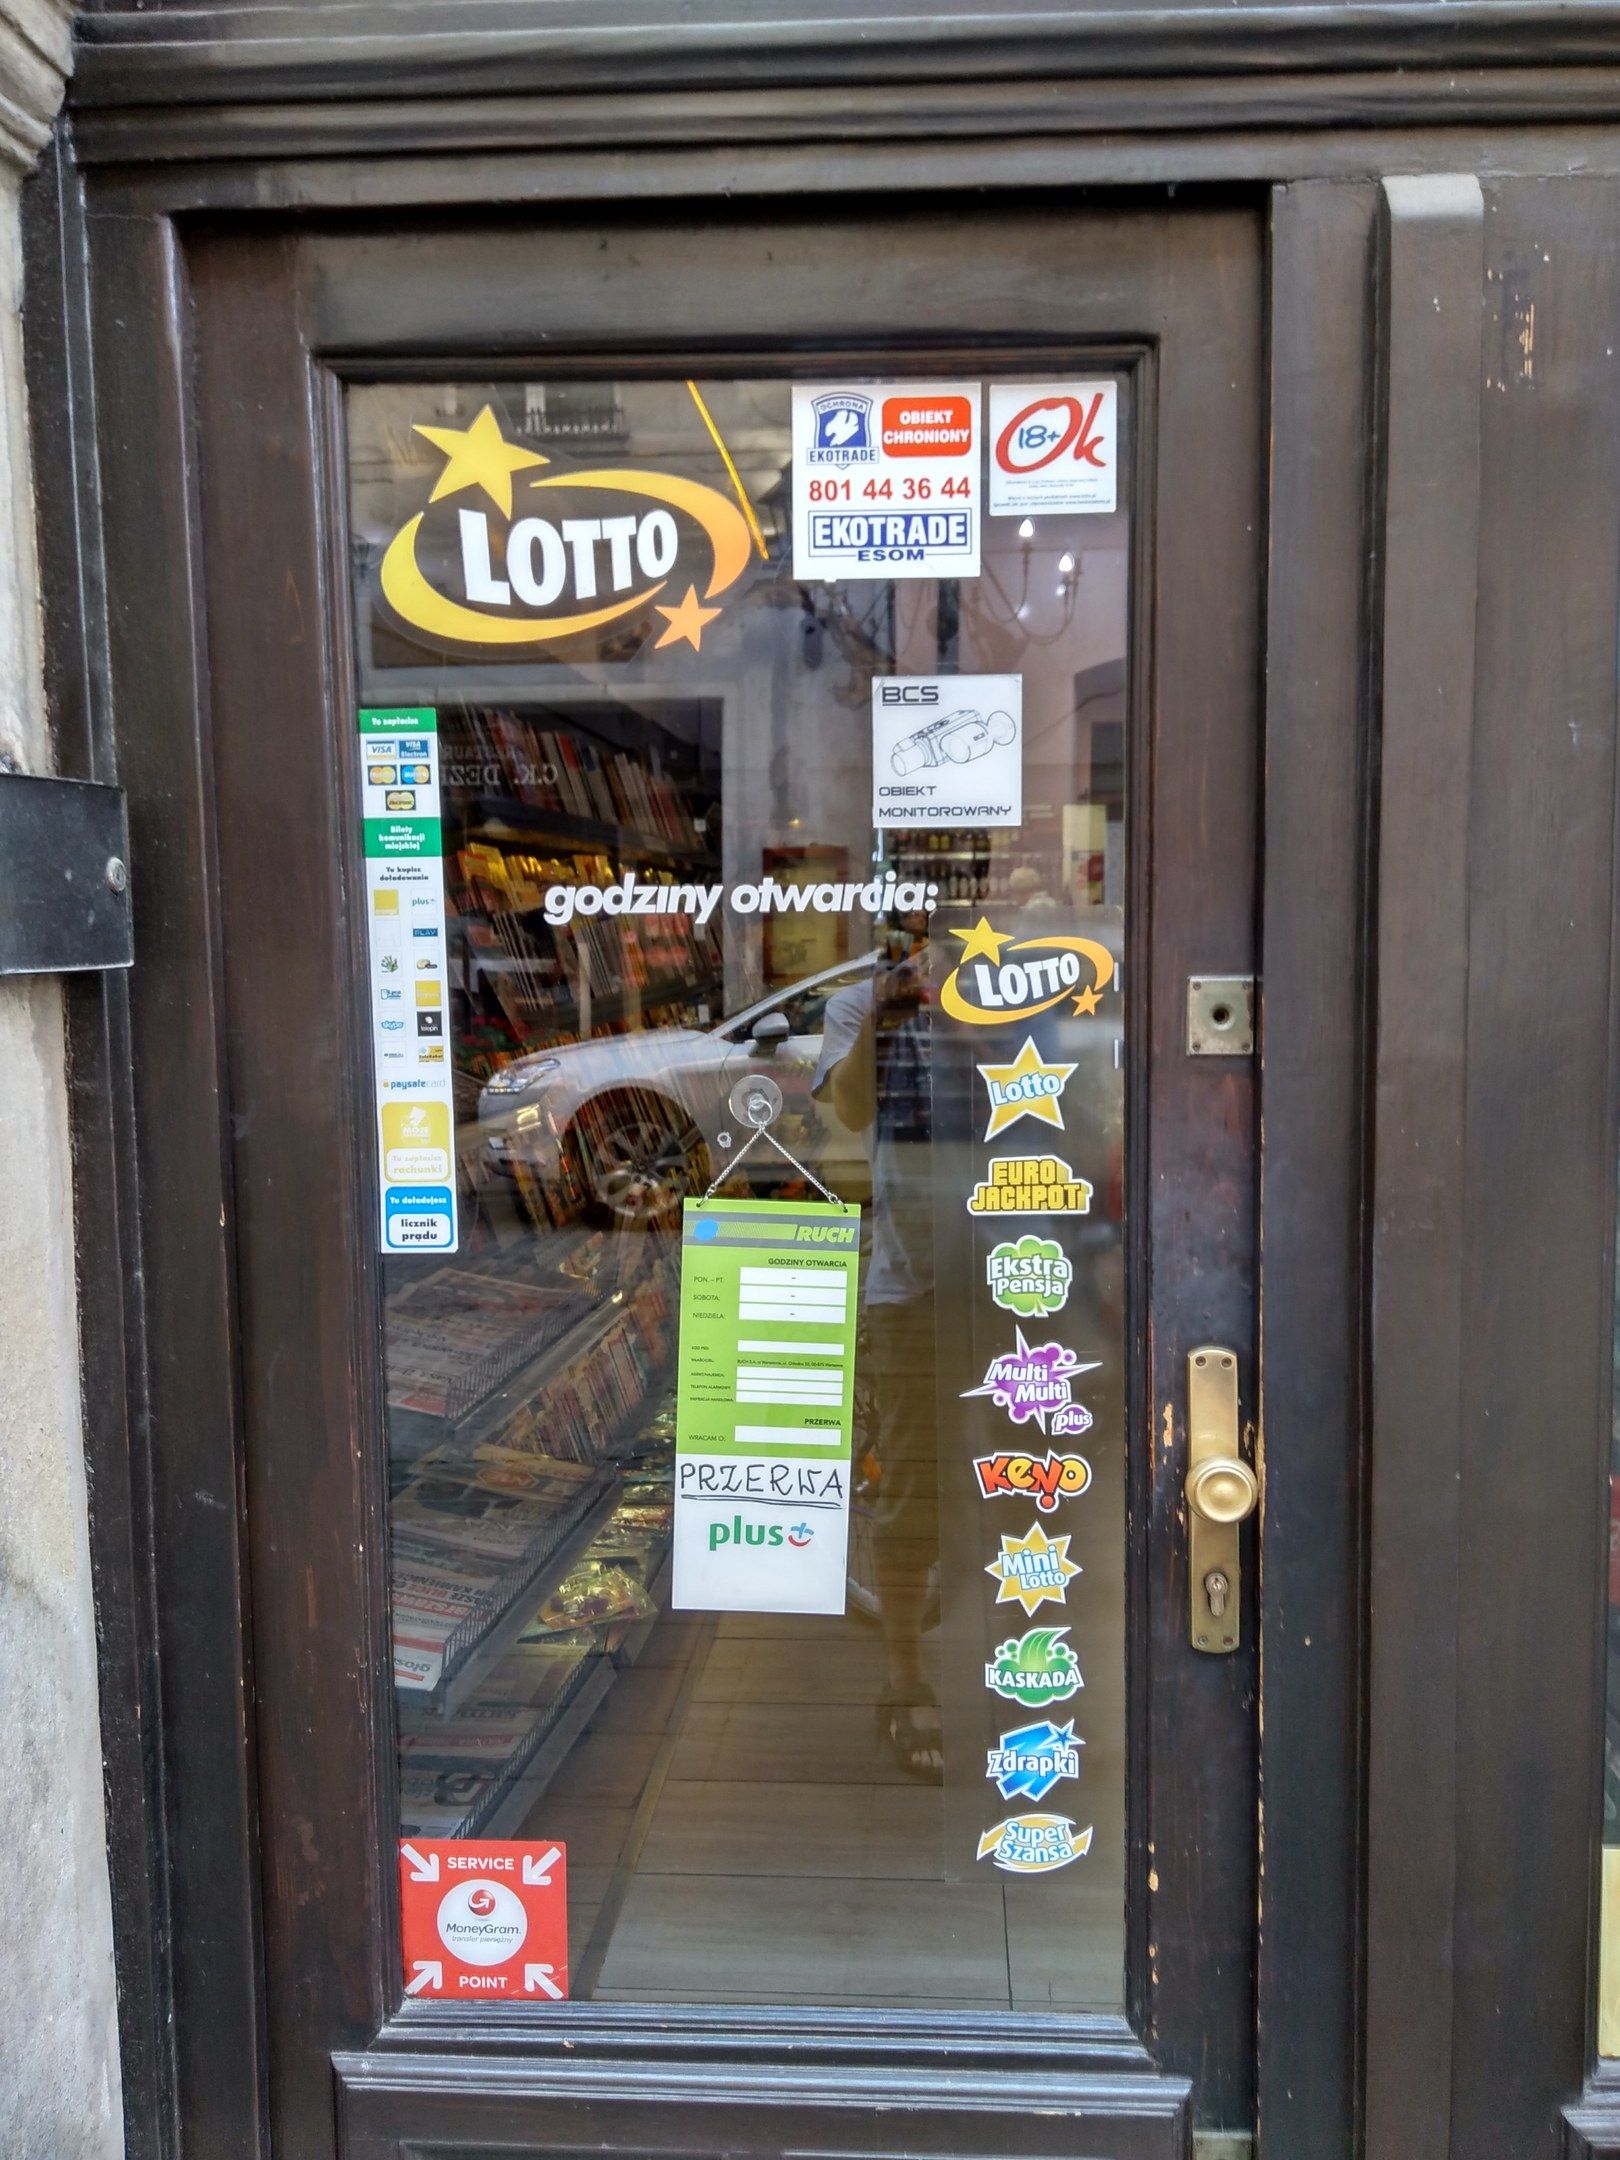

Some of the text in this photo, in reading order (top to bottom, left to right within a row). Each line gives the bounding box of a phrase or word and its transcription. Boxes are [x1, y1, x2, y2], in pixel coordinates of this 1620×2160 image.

[819, 397, 865, 412] OCHRONA
[899, 410, 954, 425] OBIEKT
[883, 427, 970, 445] CHRONIONY
[1018, 426, 1061, 449] 18+
[809, 448, 876, 463] EKOTRADE
[809, 476, 971, 501] 801 44 36 44
[814, 517, 967, 548] EKOTRADE
[458, 508, 678, 607] LOTTO
[858, 549, 925, 562] ESOM
[882, 685, 939, 703] BCS
[371, 746, 392, 754] VISA
[405, 741, 421, 749] VISA
[400, 751, 428, 759] Electron
[878, 785, 937, 797] OBIEKT
[878, 805, 1012, 818] MONITOROWANY
[731, 871, 939, 912] otwarcia:
[411, 897, 430, 907] plus
[413, 929, 437, 937] PLAY
[974, 952, 1081, 1007] LOTTO
[390, 1080, 446, 1091] paysafecard
[991, 1071, 1062, 1108] Lotto
[393, 1164, 442, 1174] rachunki
[992, 1159, 1059, 1187] EURO
[389, 1196, 400, 1205] Tu
[971, 1183, 1084, 1212] JACKPOT
[400, 1218, 438, 1228] licznik
[401, 1229, 438, 1242] prądu
[796, 1226, 855, 1244] RUCH
[767, 1257, 848, 1269] GODZINY OTWARCIA
[989, 1253, 1070, 1280] Ekstra
[995, 1275, 1065, 1298] Pensja
[990, 1361, 1049, 1382] Multi
[1014, 1380, 1069, 1403] Multi
[804, 1417, 842, 1427] PRZERWA
[1055, 1409, 1091, 1434] plus
[688, 1434, 718, 1442] WRACAM
[680, 1462, 844, 1499] PRZERWA
[708, 1515, 784, 1552] plus
[1001, 1544, 1060, 1578] Mini
[1019, 1570, 1067, 1591] Lotto
[988, 1669, 1079, 1690] KASKADA
[989, 1749, 1078, 1779] Zdrapki
[1003, 1820, 1067, 1847] Super
[998, 1841, 1074, 1864] Szansa
[447, 1856, 515, 1871] SERVICE
[446, 1921, 521, 1937] MoneyGram
[451, 1935, 480, 1943] transfer
[459, 1975, 508, 1989] POINT
